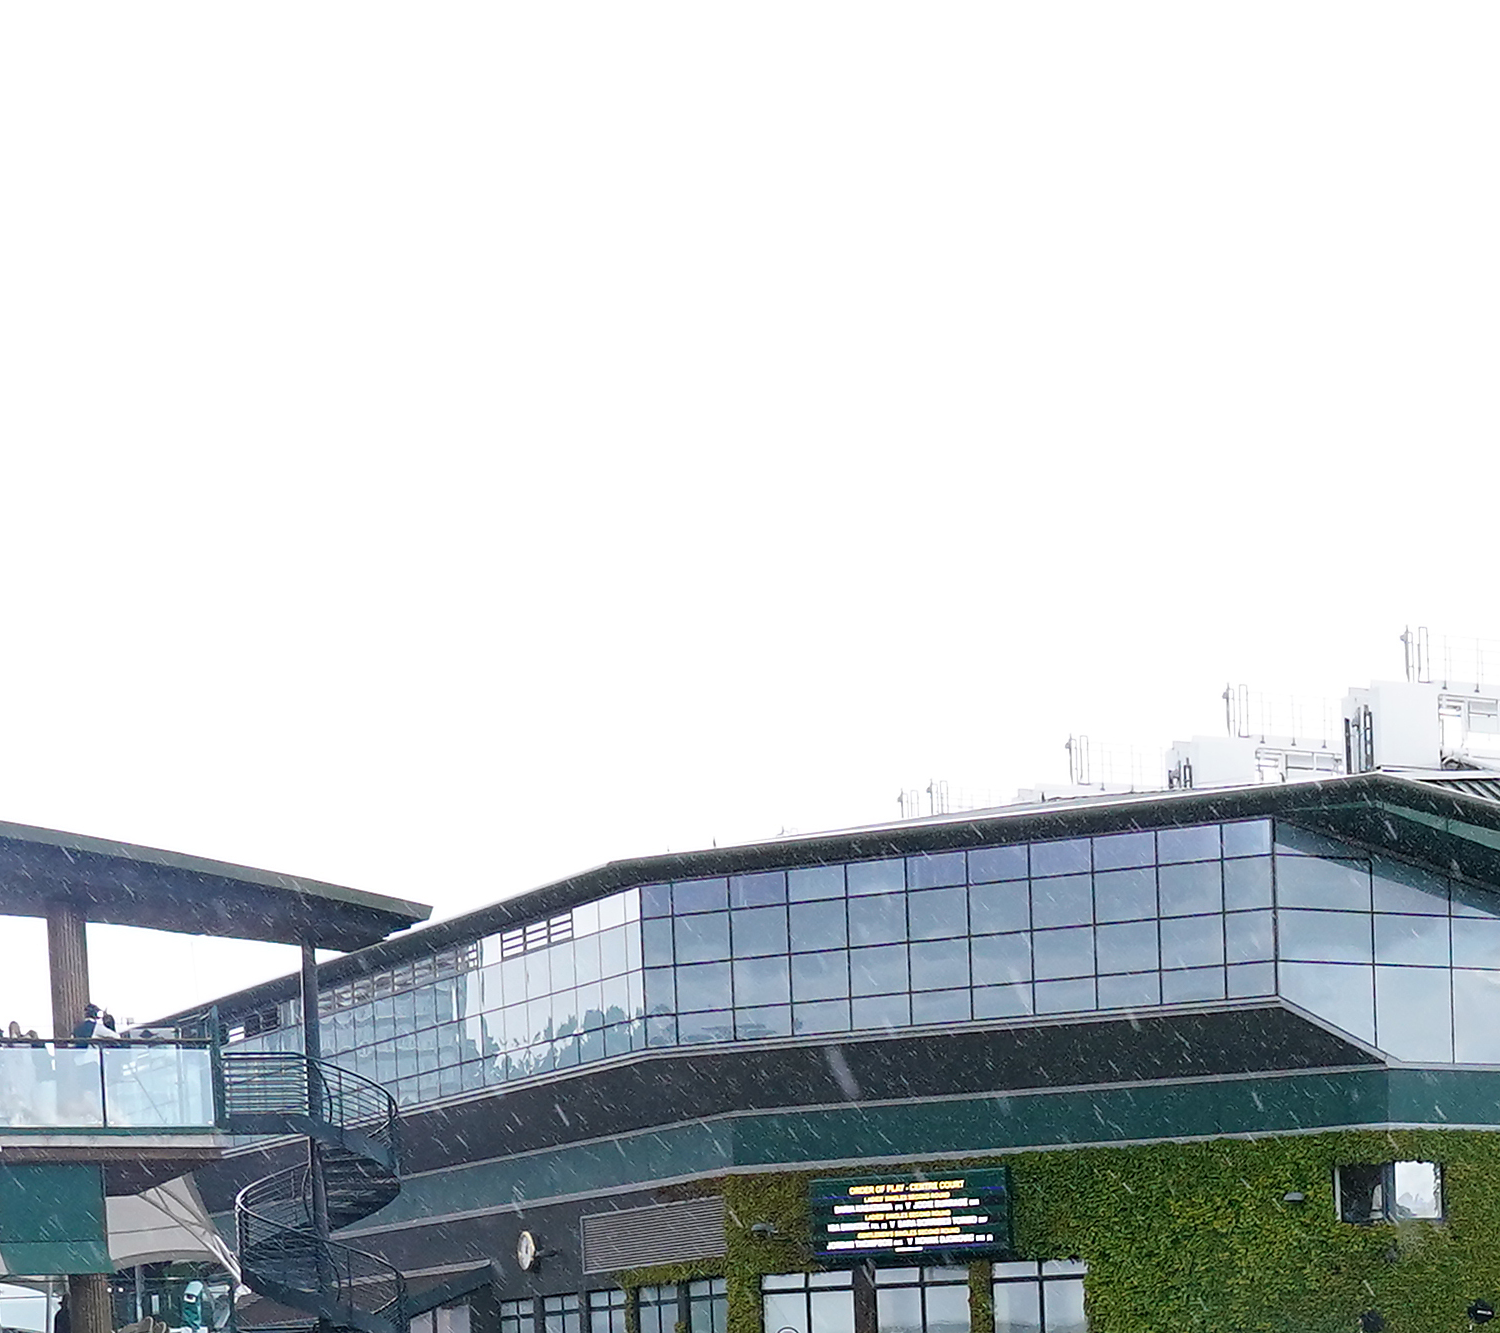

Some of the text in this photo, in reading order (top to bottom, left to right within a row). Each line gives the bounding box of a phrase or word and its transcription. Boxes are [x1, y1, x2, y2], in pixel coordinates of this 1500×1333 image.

[849, 1186, 874, 1195] ORDER
[875, 1185, 886, 1193] OF
[887, 1184, 905, 1192] PLAY
[939, 1180, 964, 1189] COURT
